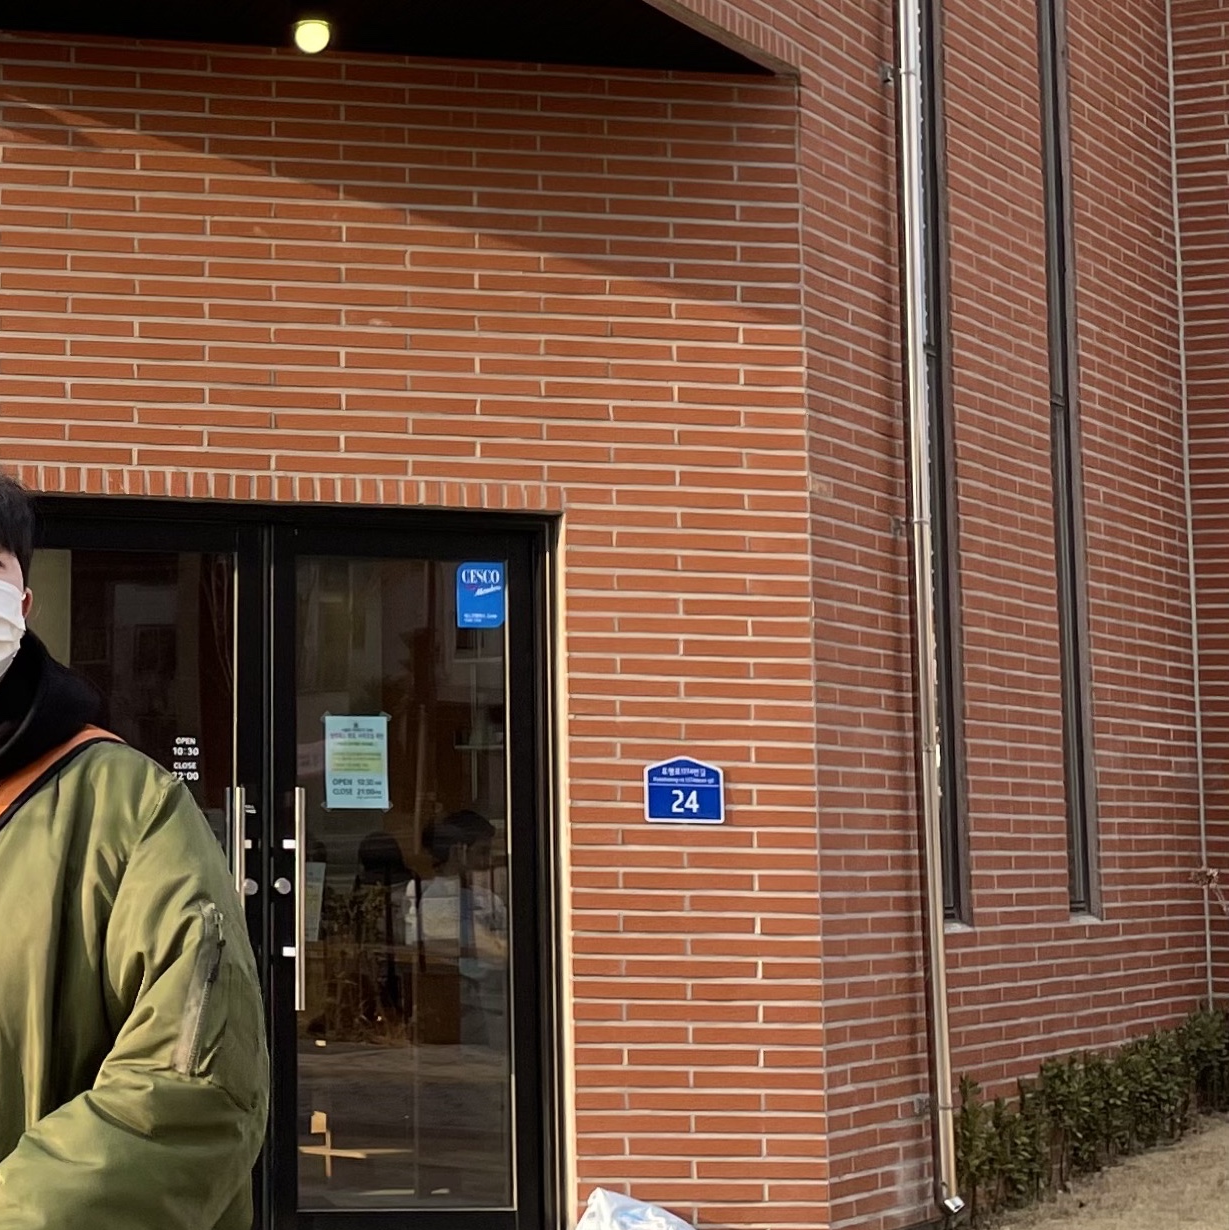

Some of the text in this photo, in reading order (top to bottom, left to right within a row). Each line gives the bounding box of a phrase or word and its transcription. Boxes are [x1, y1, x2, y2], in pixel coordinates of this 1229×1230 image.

[461, 568, 500, 584] CESCO
[175, 736, 196, 745] OPEN
[172, 746, 200, 756] 10:30
[173, 761, 197, 770] CLOSE
[332, 778, 353, 786] OPEN
[332, 788, 353, 796] CLOSE
[671, 789, 700, 814] 24
